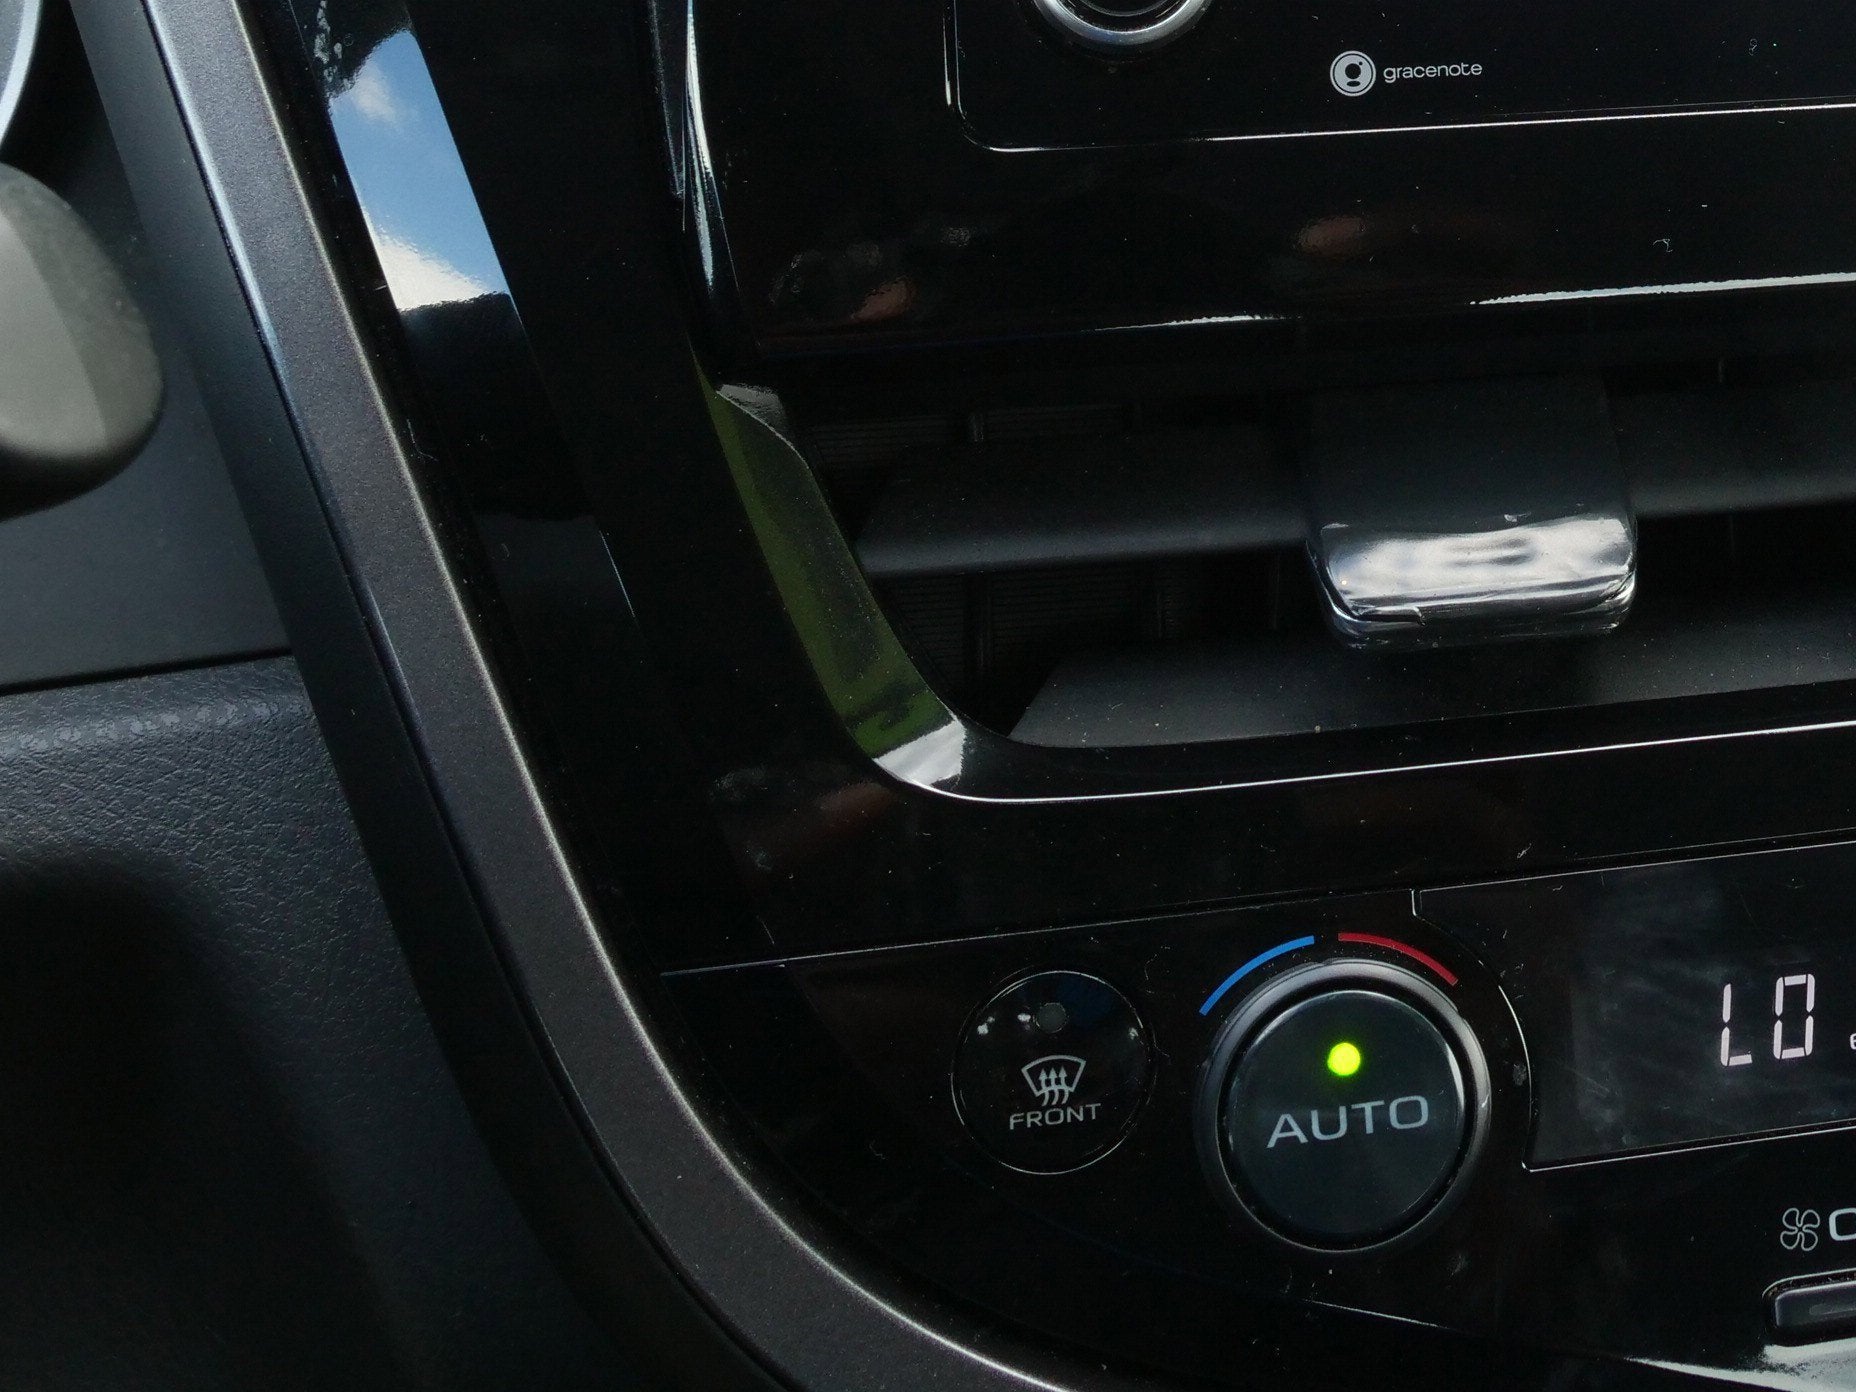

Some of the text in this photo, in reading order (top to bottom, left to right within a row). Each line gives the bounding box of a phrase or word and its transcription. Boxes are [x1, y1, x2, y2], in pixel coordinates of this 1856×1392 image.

[1383, 62, 1483, 84] gracenote
[1009, 1103, 1101, 1131] FRONT
[1266, 1095, 1430, 1149] AUTO
